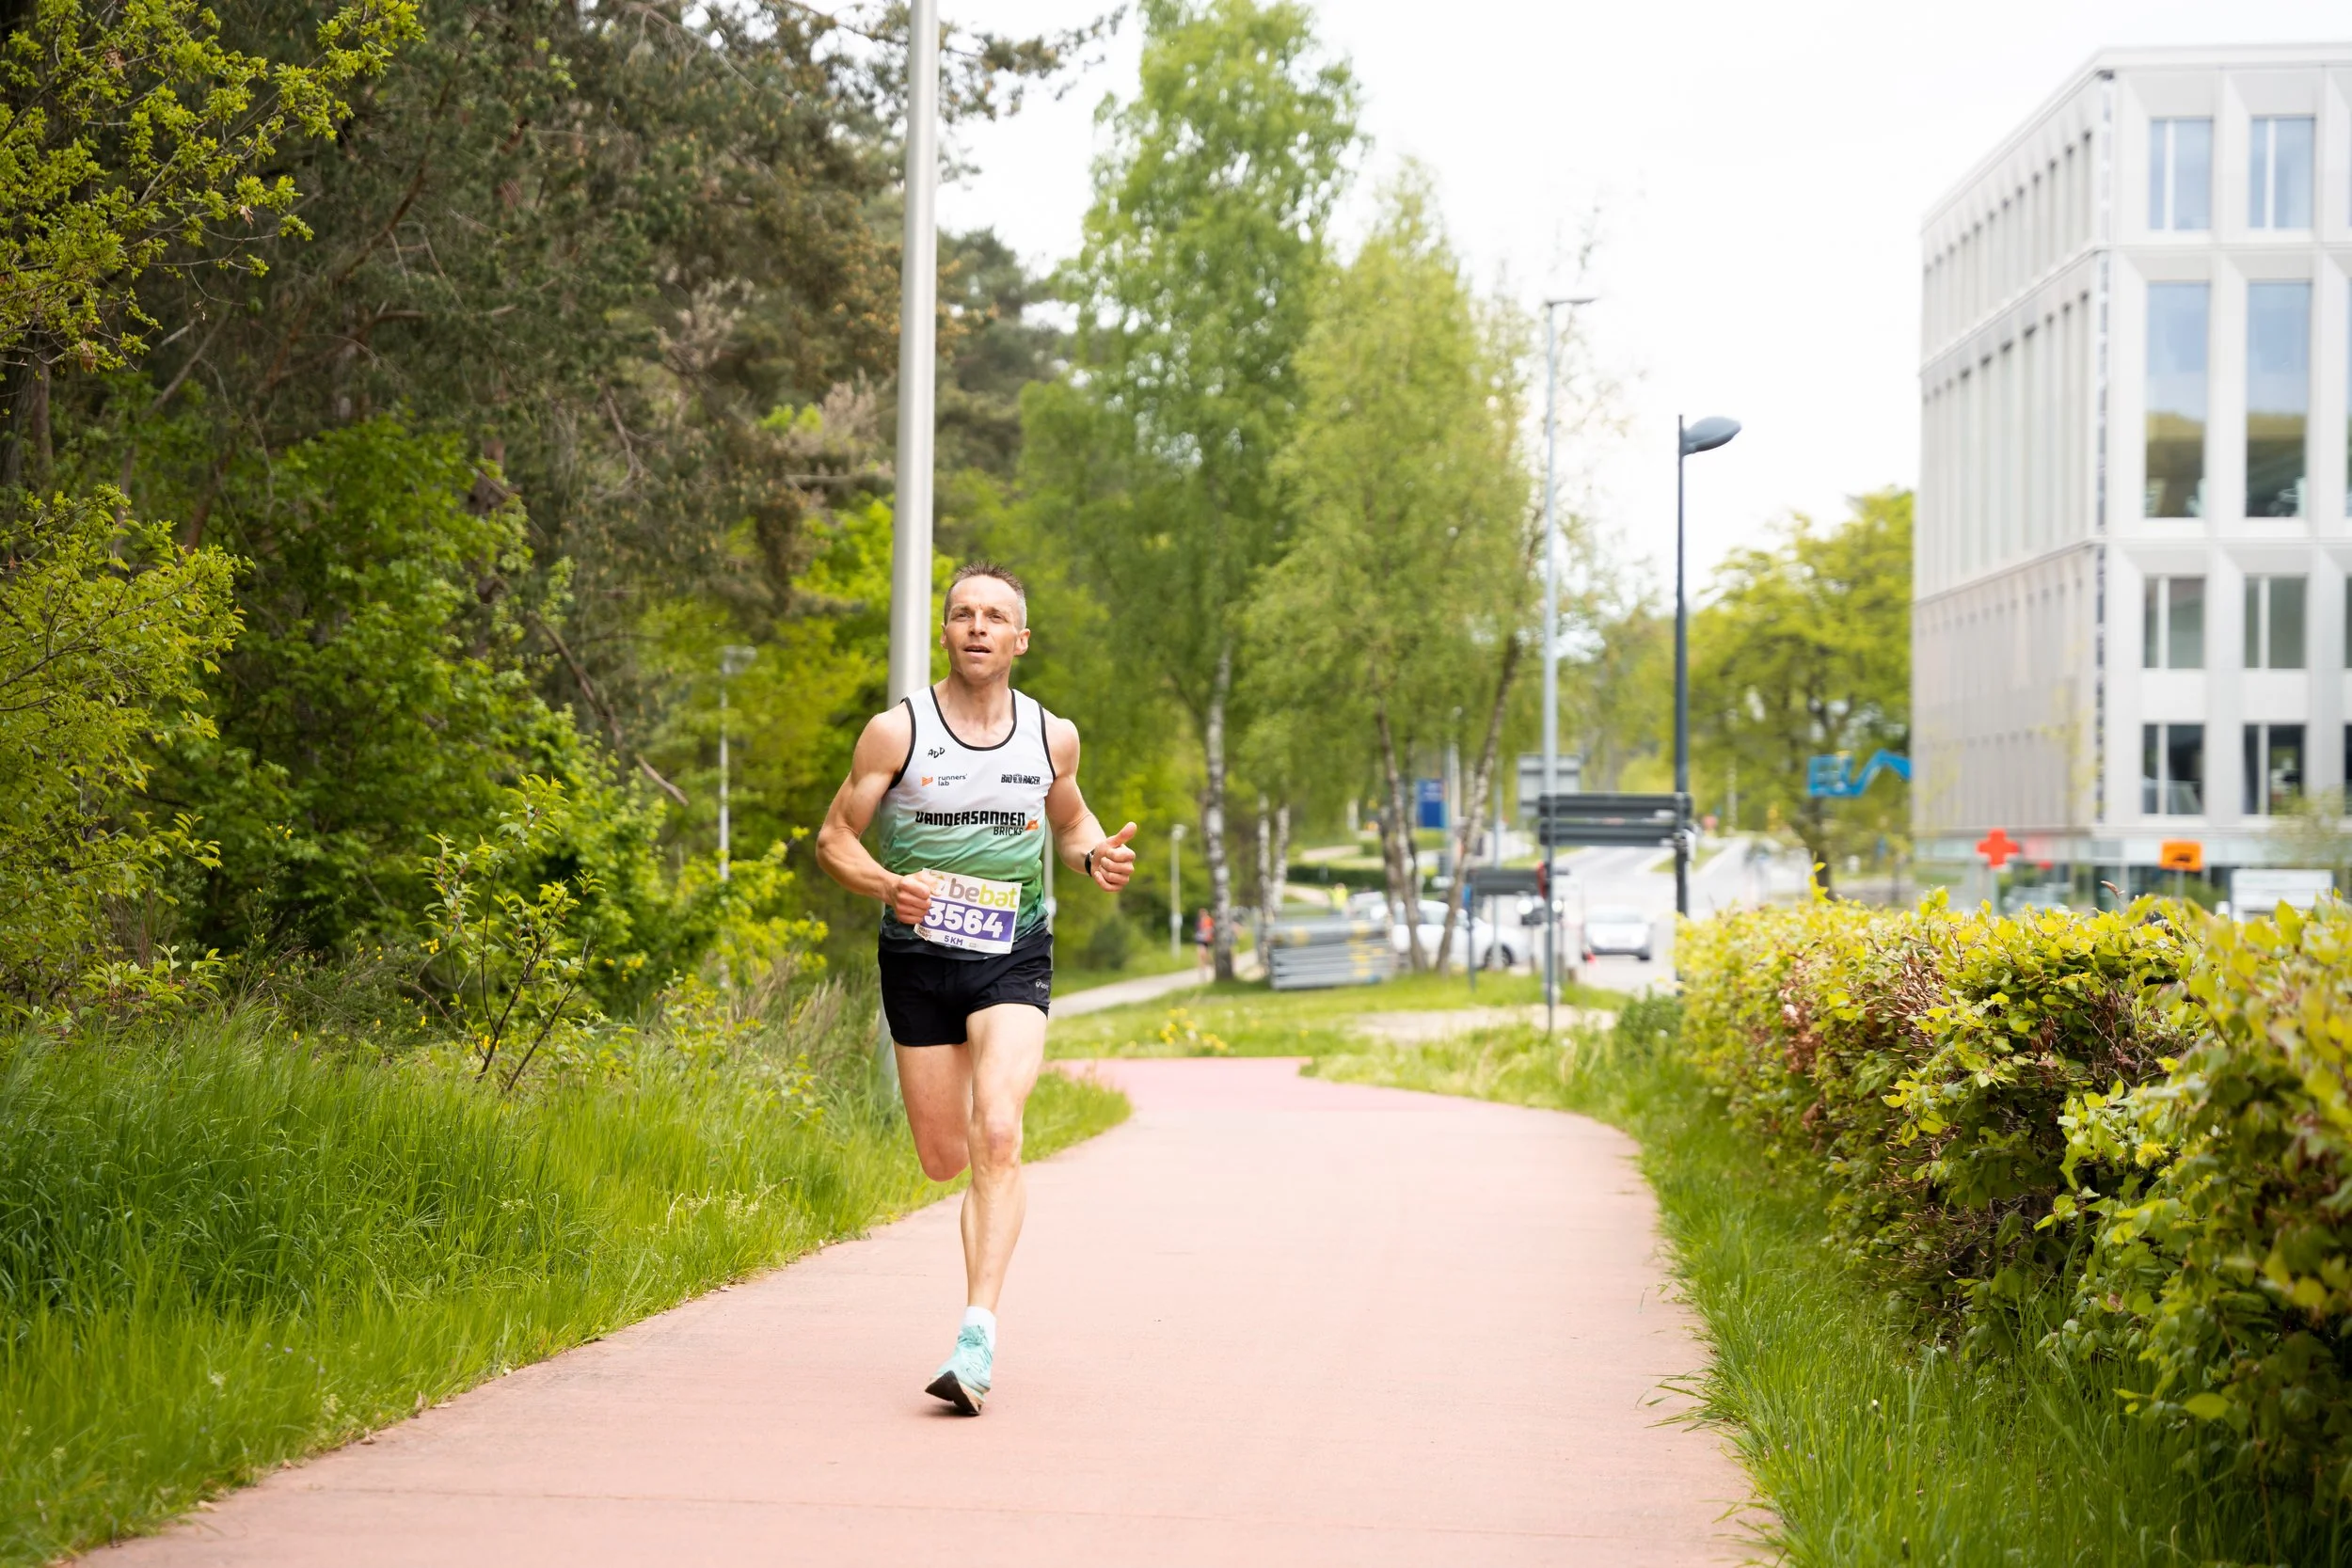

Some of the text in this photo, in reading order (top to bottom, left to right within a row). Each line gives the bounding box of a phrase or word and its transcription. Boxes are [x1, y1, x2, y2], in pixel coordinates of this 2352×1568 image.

[915, 811, 1025, 826] VANDERSANDEN
[993, 827, 1024, 836] BRICKS
[948, 878, 1017, 909] bebat
[924, 900, 1004, 939] 3564
[950, 937, 963, 946] KM
